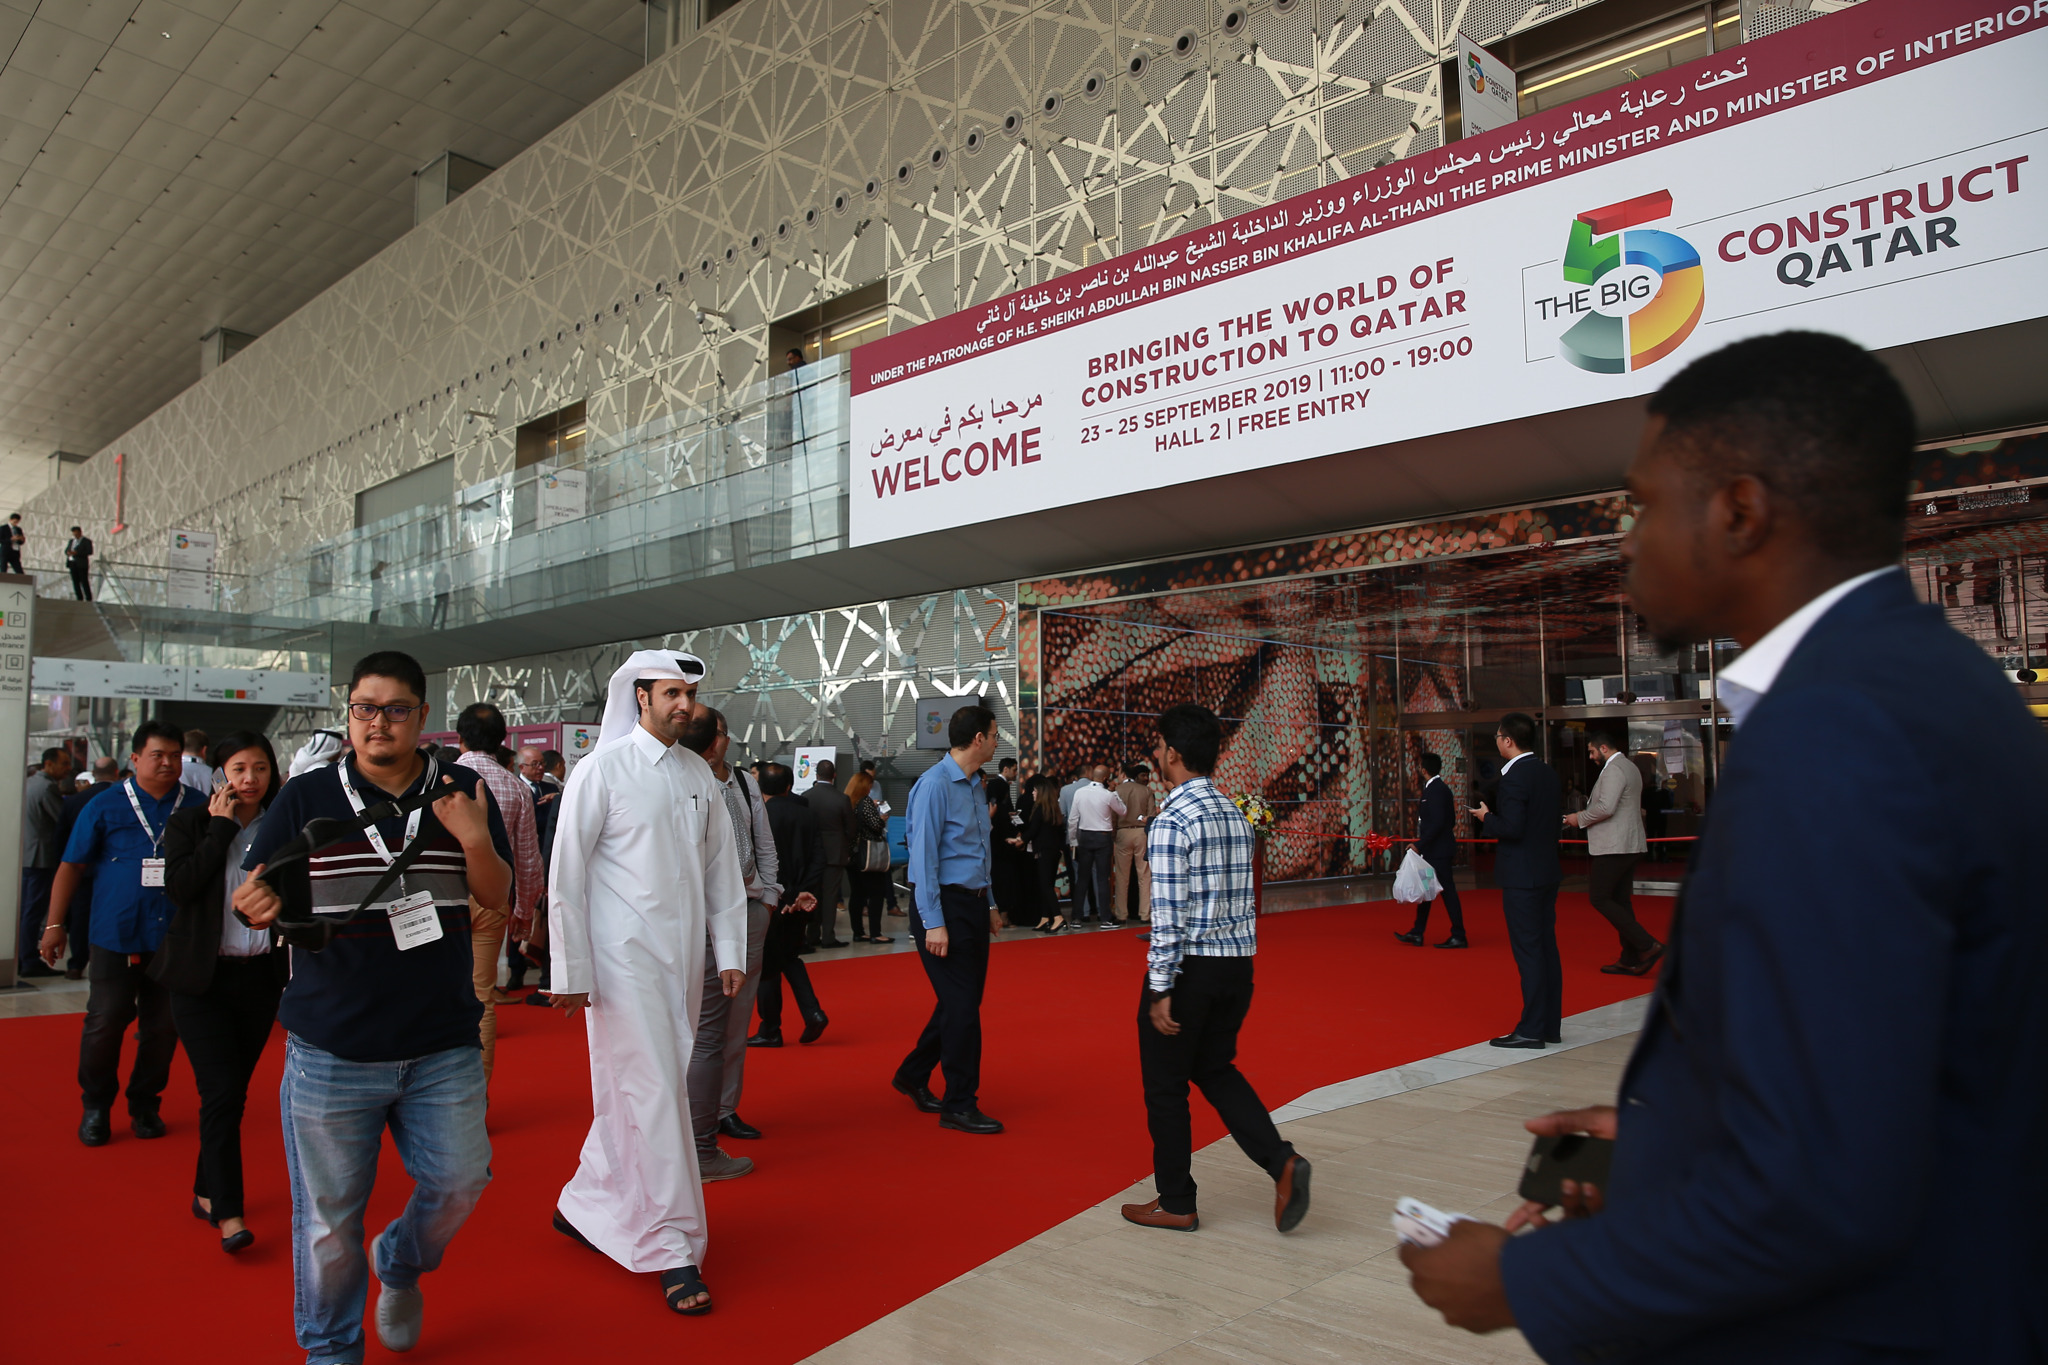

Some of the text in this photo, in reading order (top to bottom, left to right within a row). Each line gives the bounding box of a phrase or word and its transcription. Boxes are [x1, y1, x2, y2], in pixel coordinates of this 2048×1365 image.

[1485, 75, 1513, 100] CONSTRUCT
[1491, 87, 1508, 103] QATAR
[870, 0, 2048, 385] UNDER THE PATRONAGE OF H.E. SHEIKH ABDULLAH BIN NASSER BIN KHALIFA AL-THANI THE PRIME MINISTER AND MINISTER OF INTERIOR
[976, 56, 1748, 334] تحت رعاية معالي رئيس مجلس الوزراء ووزير الداخلية الشيخ عبدالله بن ناصر بن خليفة آل ثاني
[1717, 154, 2029, 263] CONSTRUCT
[1776, 216, 1961, 289] QATAR
[1088, 256, 1454, 379] BRINGING THE WORLD OF
[1534, 288, 1592, 321] THE
[1600, 275, 1650, 307] BIG
[1081, 289, 1467, 408] CONSTRUCTION TO QATAR
[870, 393, 1043, 458] مرحبا بكم في معرض
[1080, 424, 1100, 444] 23
[1118, 415, 1139, 436] 25
[1144, 387, 1257, 429] SEPTEMBER
[1263, 374, 1311, 402] 2019
[1330, 357, 1386, 386] 11:00
[1407, 336, 1473, 368] 19:00
[1155, 427, 1205, 453] HALL
[1209, 422, 1221, 441] 2
[1238, 406, 1291, 435] FREE
[1297, 388, 1371, 422] ENTRY
[871, 426, 1042, 499] WELCOME
[985, 598, 1006, 651] 2
